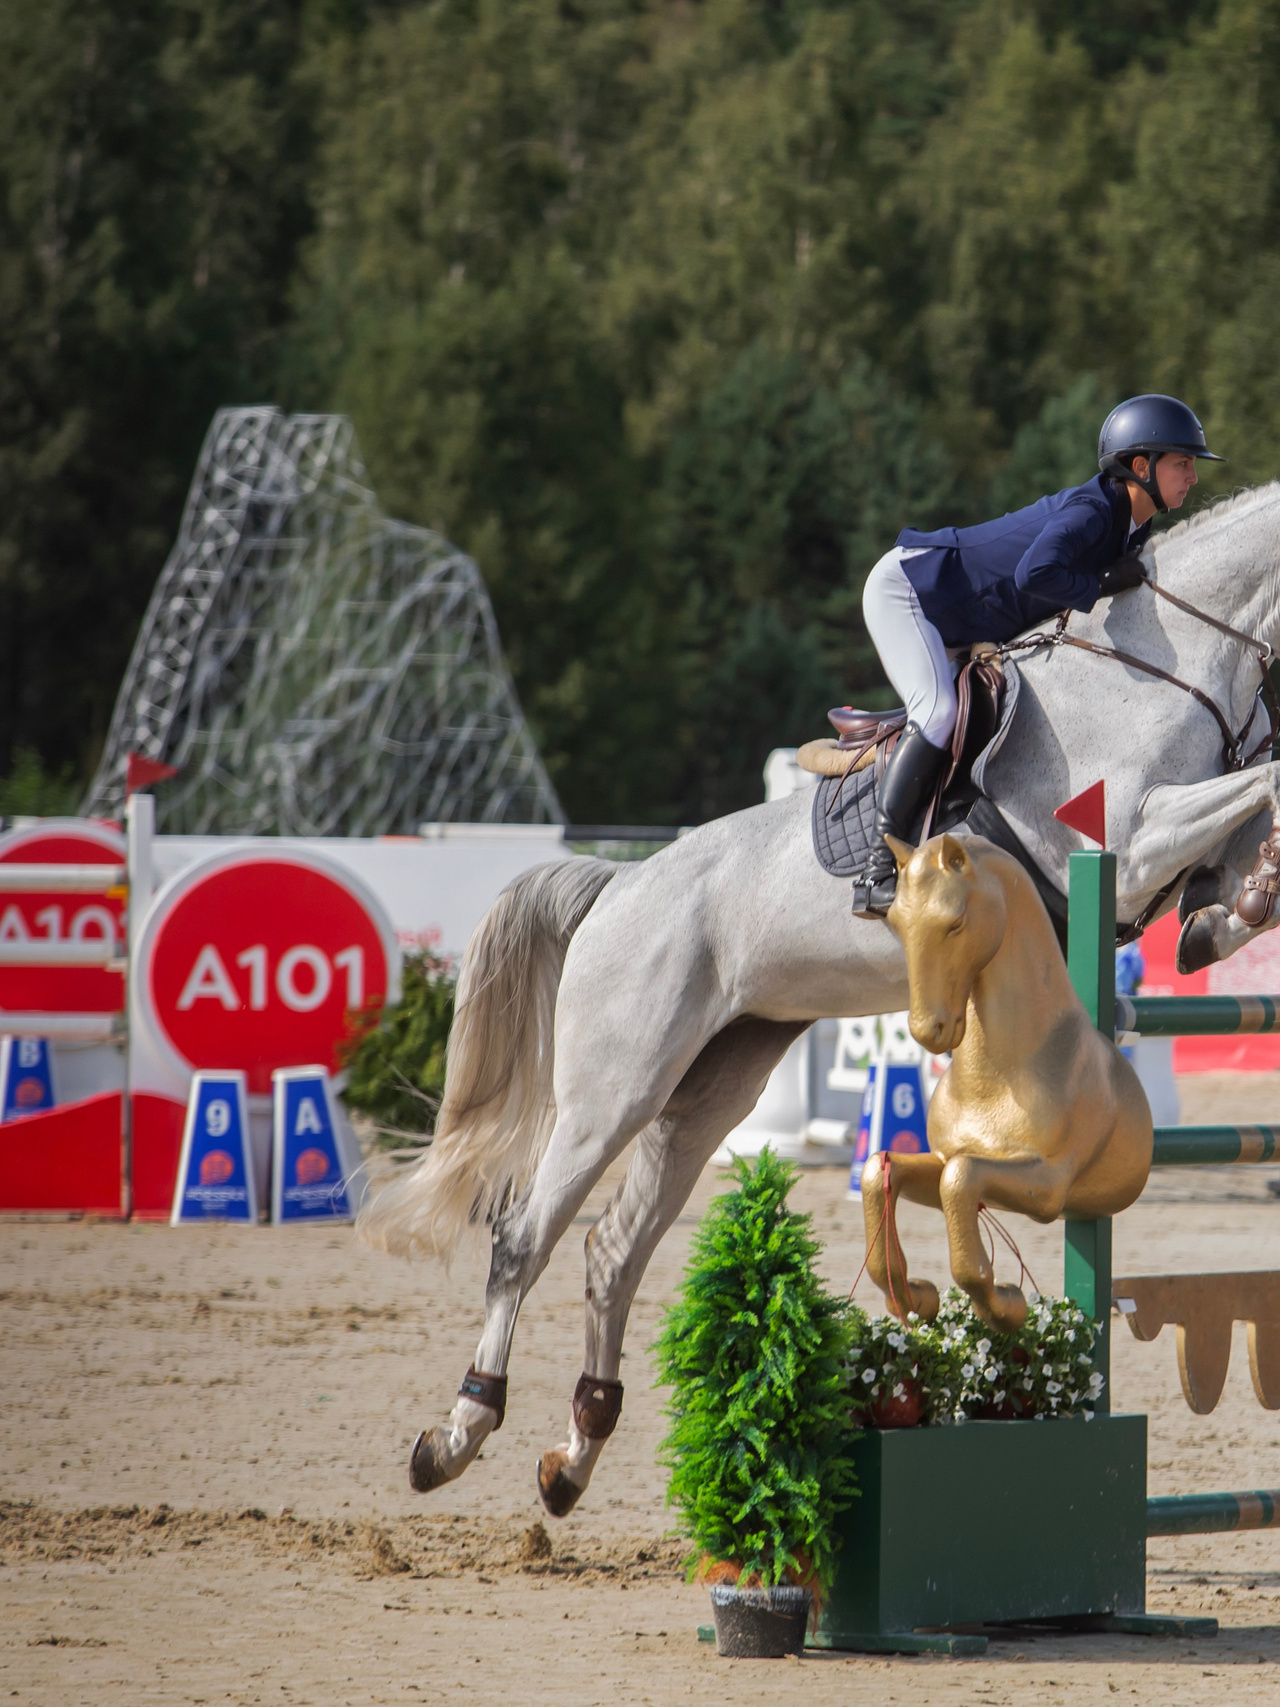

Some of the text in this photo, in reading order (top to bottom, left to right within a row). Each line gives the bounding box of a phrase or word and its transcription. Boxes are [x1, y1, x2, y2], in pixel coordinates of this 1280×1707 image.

[0, 903, 127, 942] A10
[175, 944, 365, 1012] A101
[206, 1099, 231, 1137] 9
[295, 1097, 322, 1136] A
[892, 1082, 915, 1119] 6
